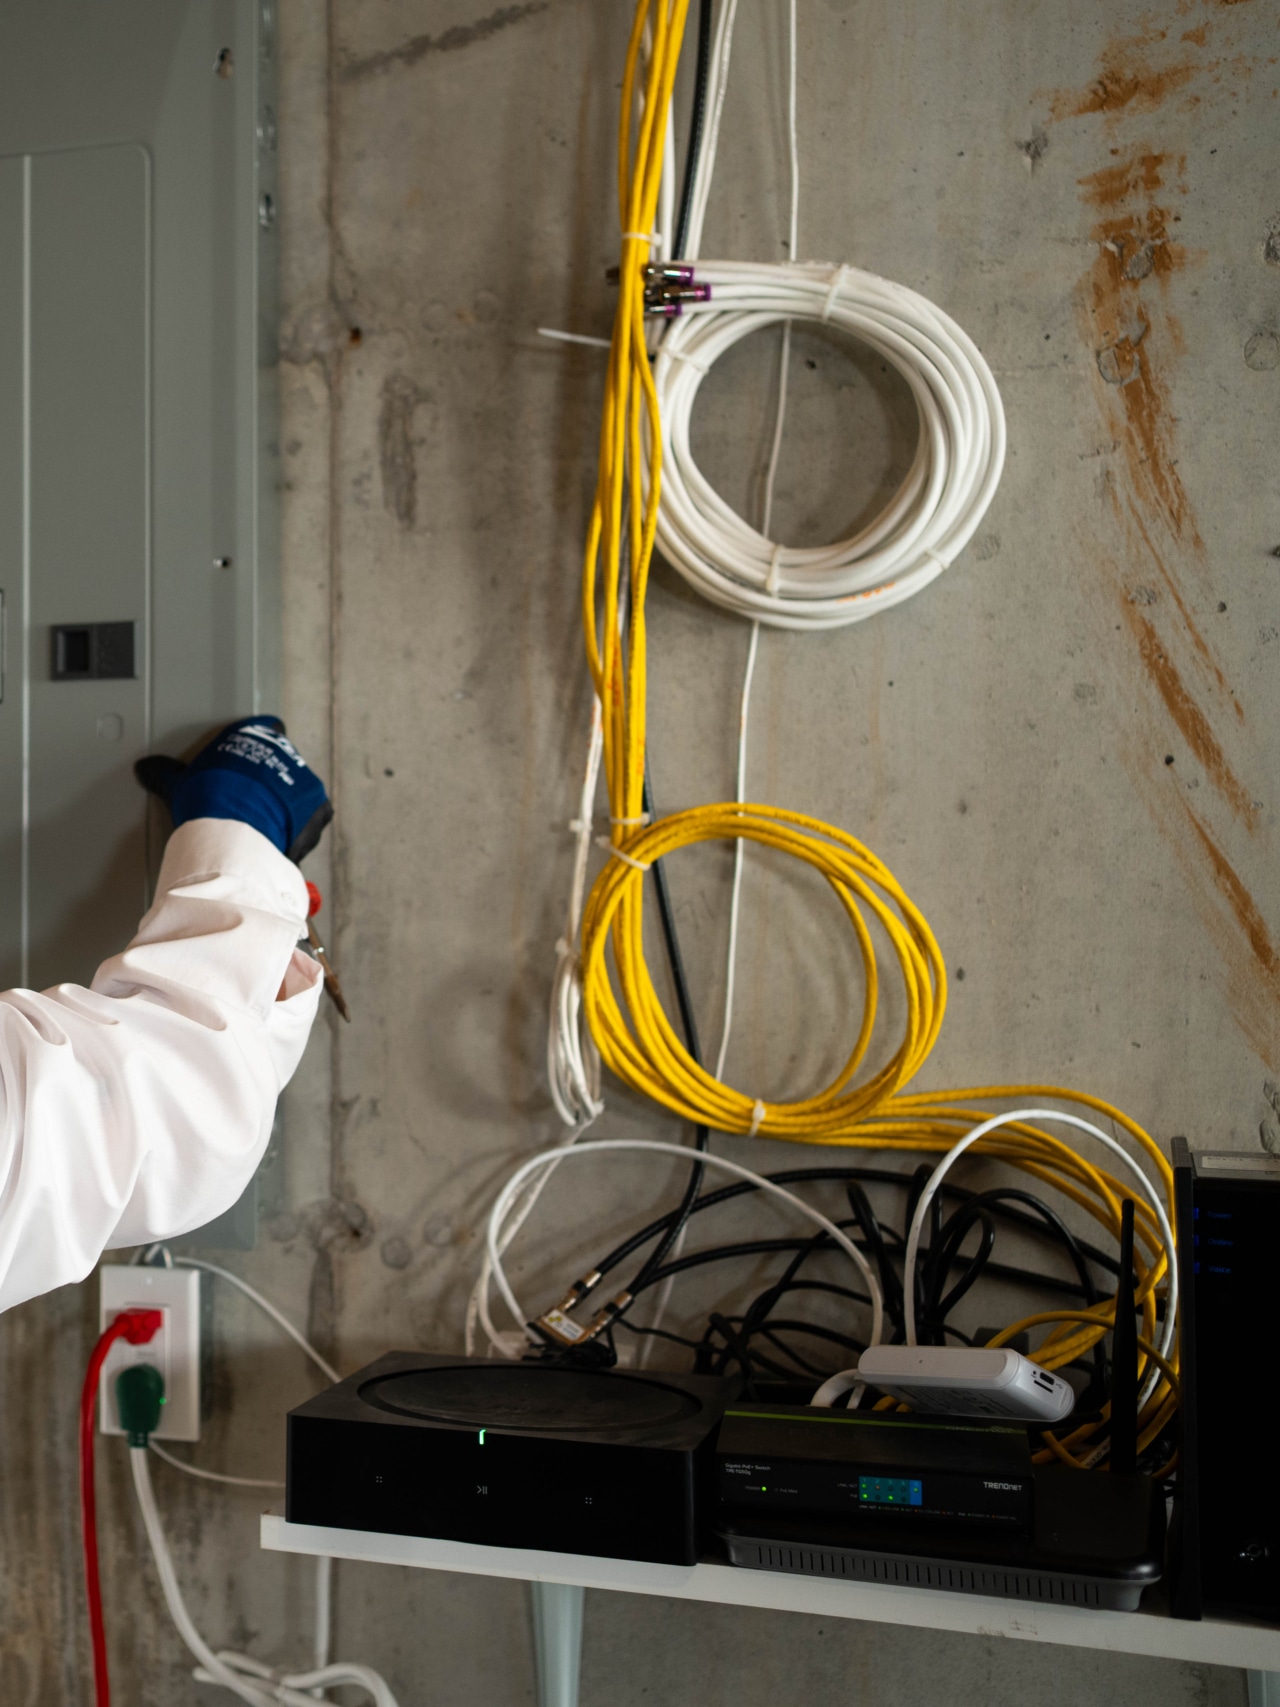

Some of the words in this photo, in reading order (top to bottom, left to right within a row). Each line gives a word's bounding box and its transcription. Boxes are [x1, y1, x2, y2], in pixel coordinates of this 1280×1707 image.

[1207, 1210, 1233, 1219] Power
[1207, 1237, 1234, 1247] Online
[1207, 1264, 1233, 1274] Voice
